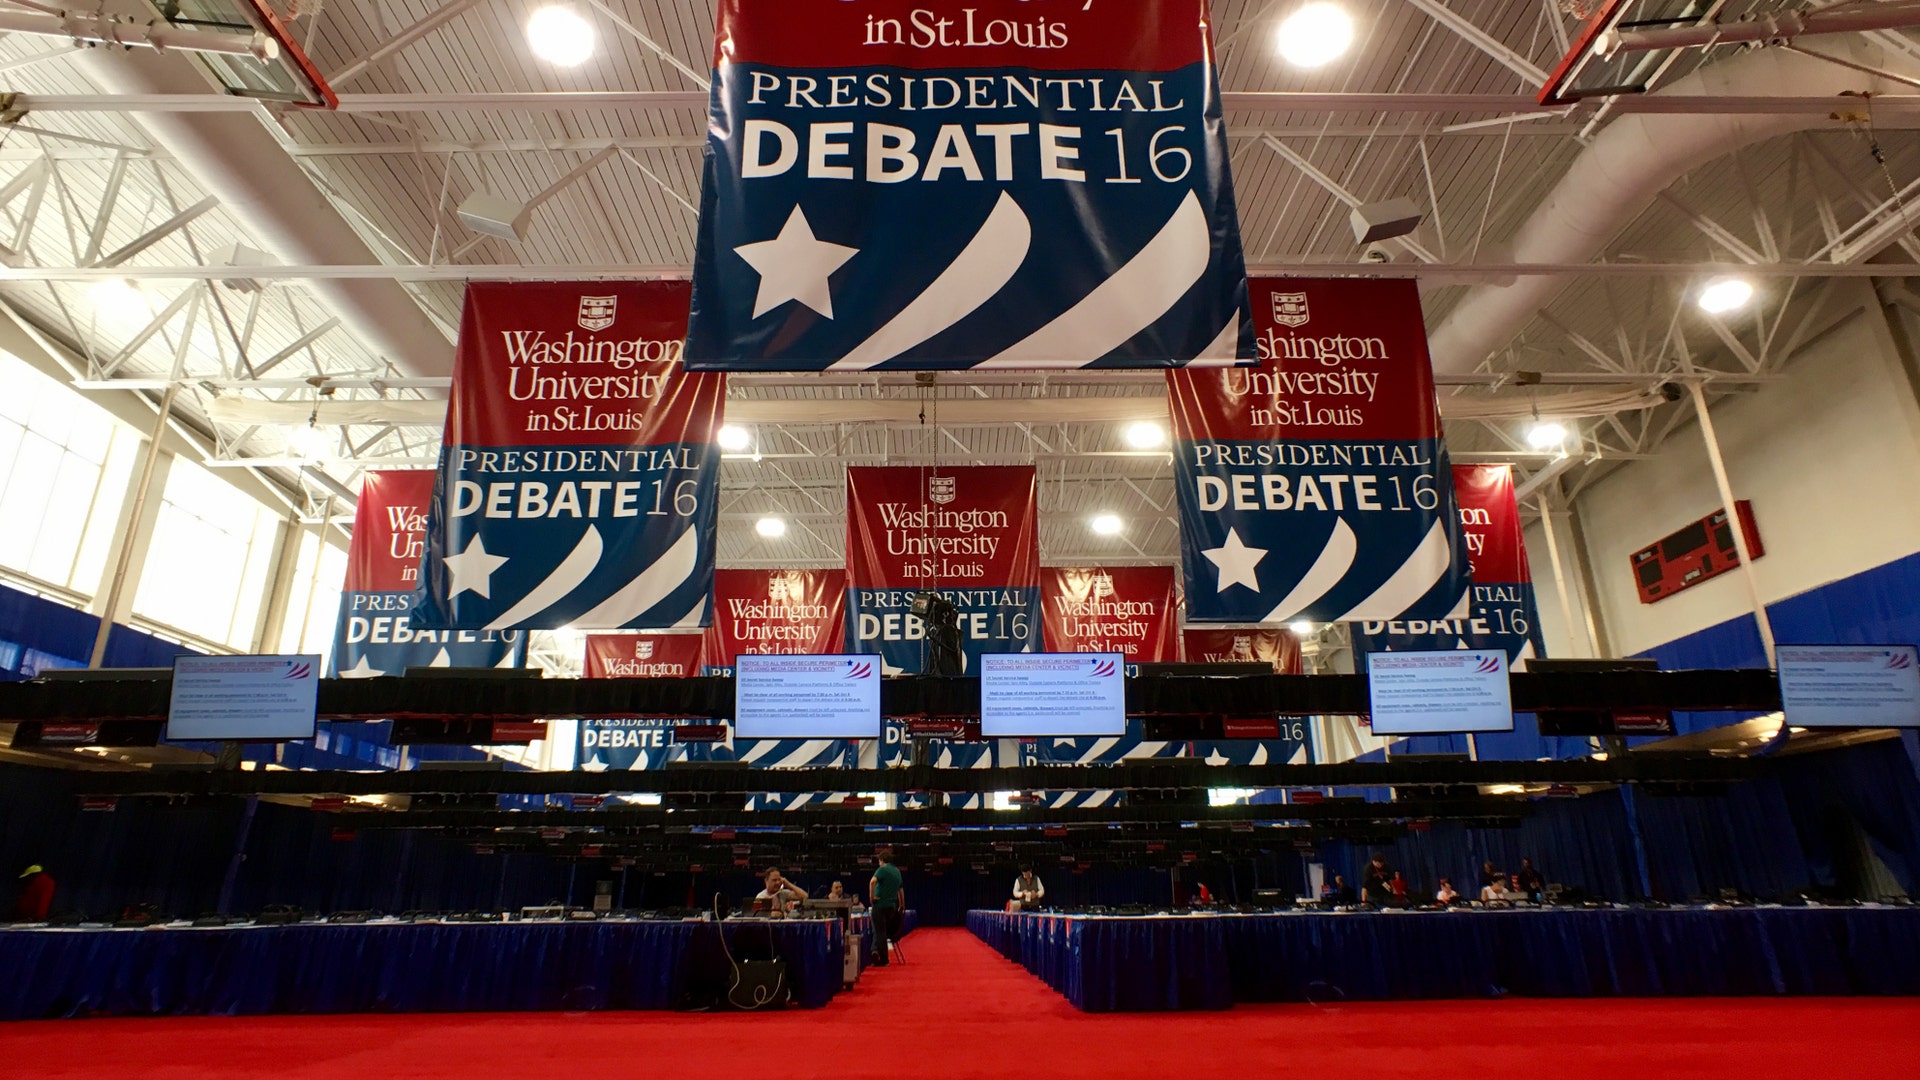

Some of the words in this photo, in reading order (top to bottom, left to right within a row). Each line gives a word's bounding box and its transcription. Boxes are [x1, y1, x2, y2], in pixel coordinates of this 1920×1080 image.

[862, 14, 906, 45] in
[747, 71, 1184, 112] PRESIDENTIAL
[742, 119, 1086, 184] DEBATE
[1104, 125, 1192, 184] 16
[501, 330, 686, 370] Washington
[1256, 327, 1390, 366] shington
[508, 366, 671, 406] University
[1222, 366, 1380, 402] University
[525, 410, 550, 432] in
[1250, 405, 1275, 426] in
[456, 448, 700, 473] PRESIDENTIAL
[1194, 444, 1432, 467] PRESIDENTIAL
[451, 480, 641, 518] DEBATE
[646, 479, 698, 517] 16
[1196, 474, 1382, 512] DEBATE
[1388, 474, 1439, 511] 16
[876, 502, 1009, 533] Washington
[886, 530, 1000, 560] University
[903, 561, 920, 578] in
[728, 598, 828, 623] Washington
[1054, 596, 1156, 620] Washington
[1494, 608, 1528, 635] 16
[734, 620, 820, 644] University
[858, 612, 988, 640] DEBTE
[995, 612, 1029, 640] 16
[1062, 616, 1148, 640] University
[602, 658, 684, 678] Washington
[583, 730, 664, 748] DEBATE
[1282, 722, 1304, 740] 16
